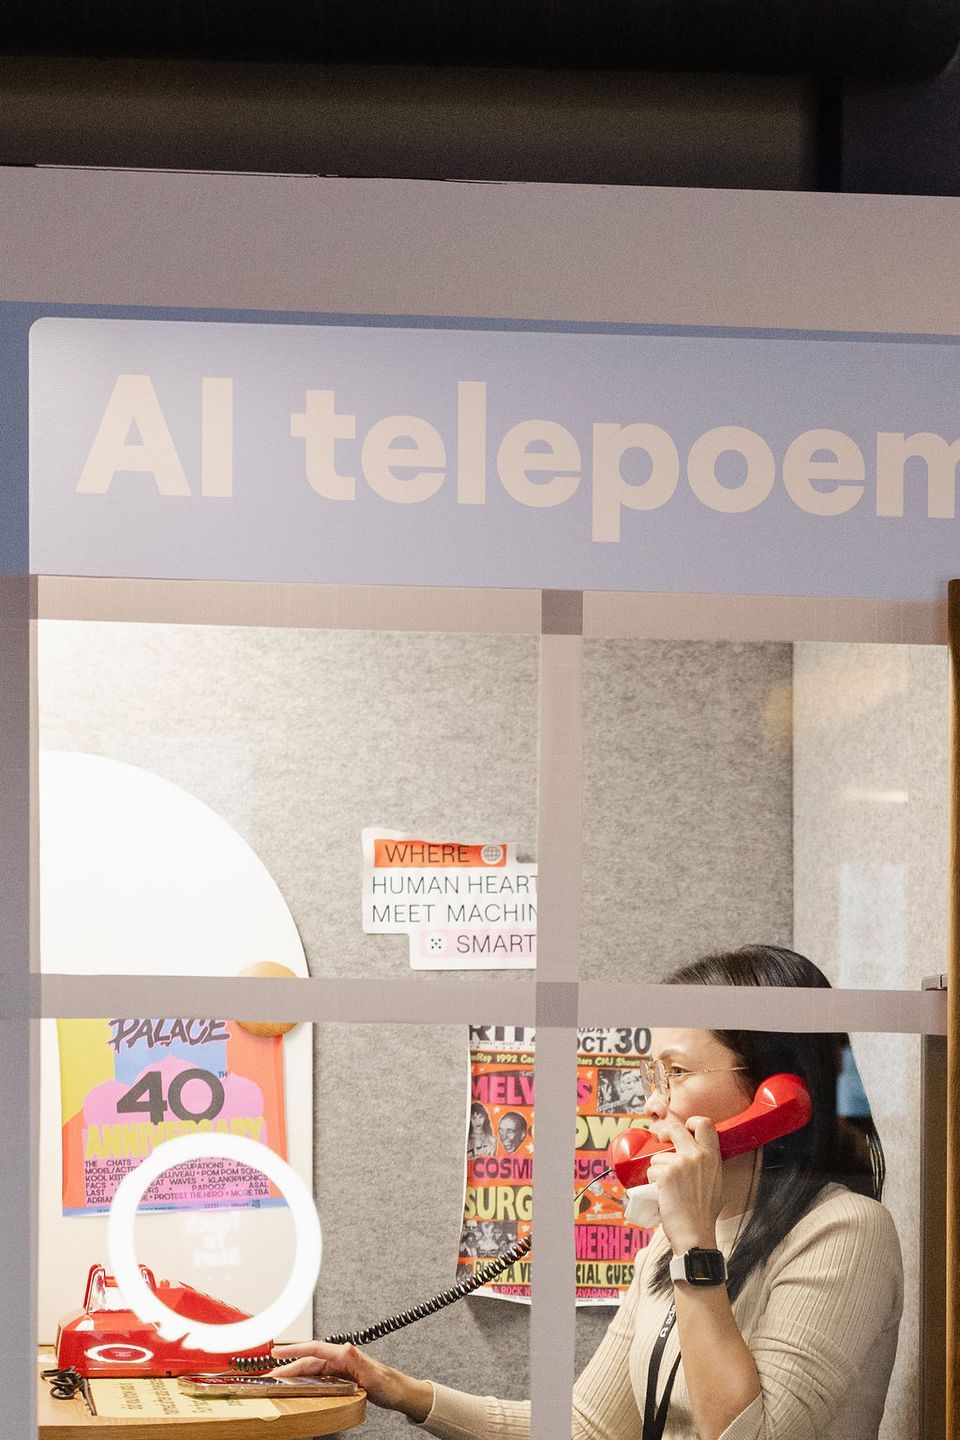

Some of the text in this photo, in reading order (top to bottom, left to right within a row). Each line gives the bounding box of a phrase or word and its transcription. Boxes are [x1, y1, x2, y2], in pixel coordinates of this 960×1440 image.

[75, 374, 233, 497] AI
[385, 844, 469, 863] WHERE
[372, 875, 459, 894] HUMAN
[372, 904, 436, 923] MEET
[457, 934, 536, 953] SMART
[108, 1018, 230, 1053] PALACE
[614, 1028, 652, 1054] 30
[496, 1053, 518, 1063] 1992
[116, 1068, 225, 1125] 40
[106, 1159, 131, 1167] CHATS
[85, 1174, 108, 1182] KOOL
[86, 1182, 106, 1190] FACS
[169, 1178, 197, 1186] WAVES
[501, 1286, 523, 1296] ROCK
